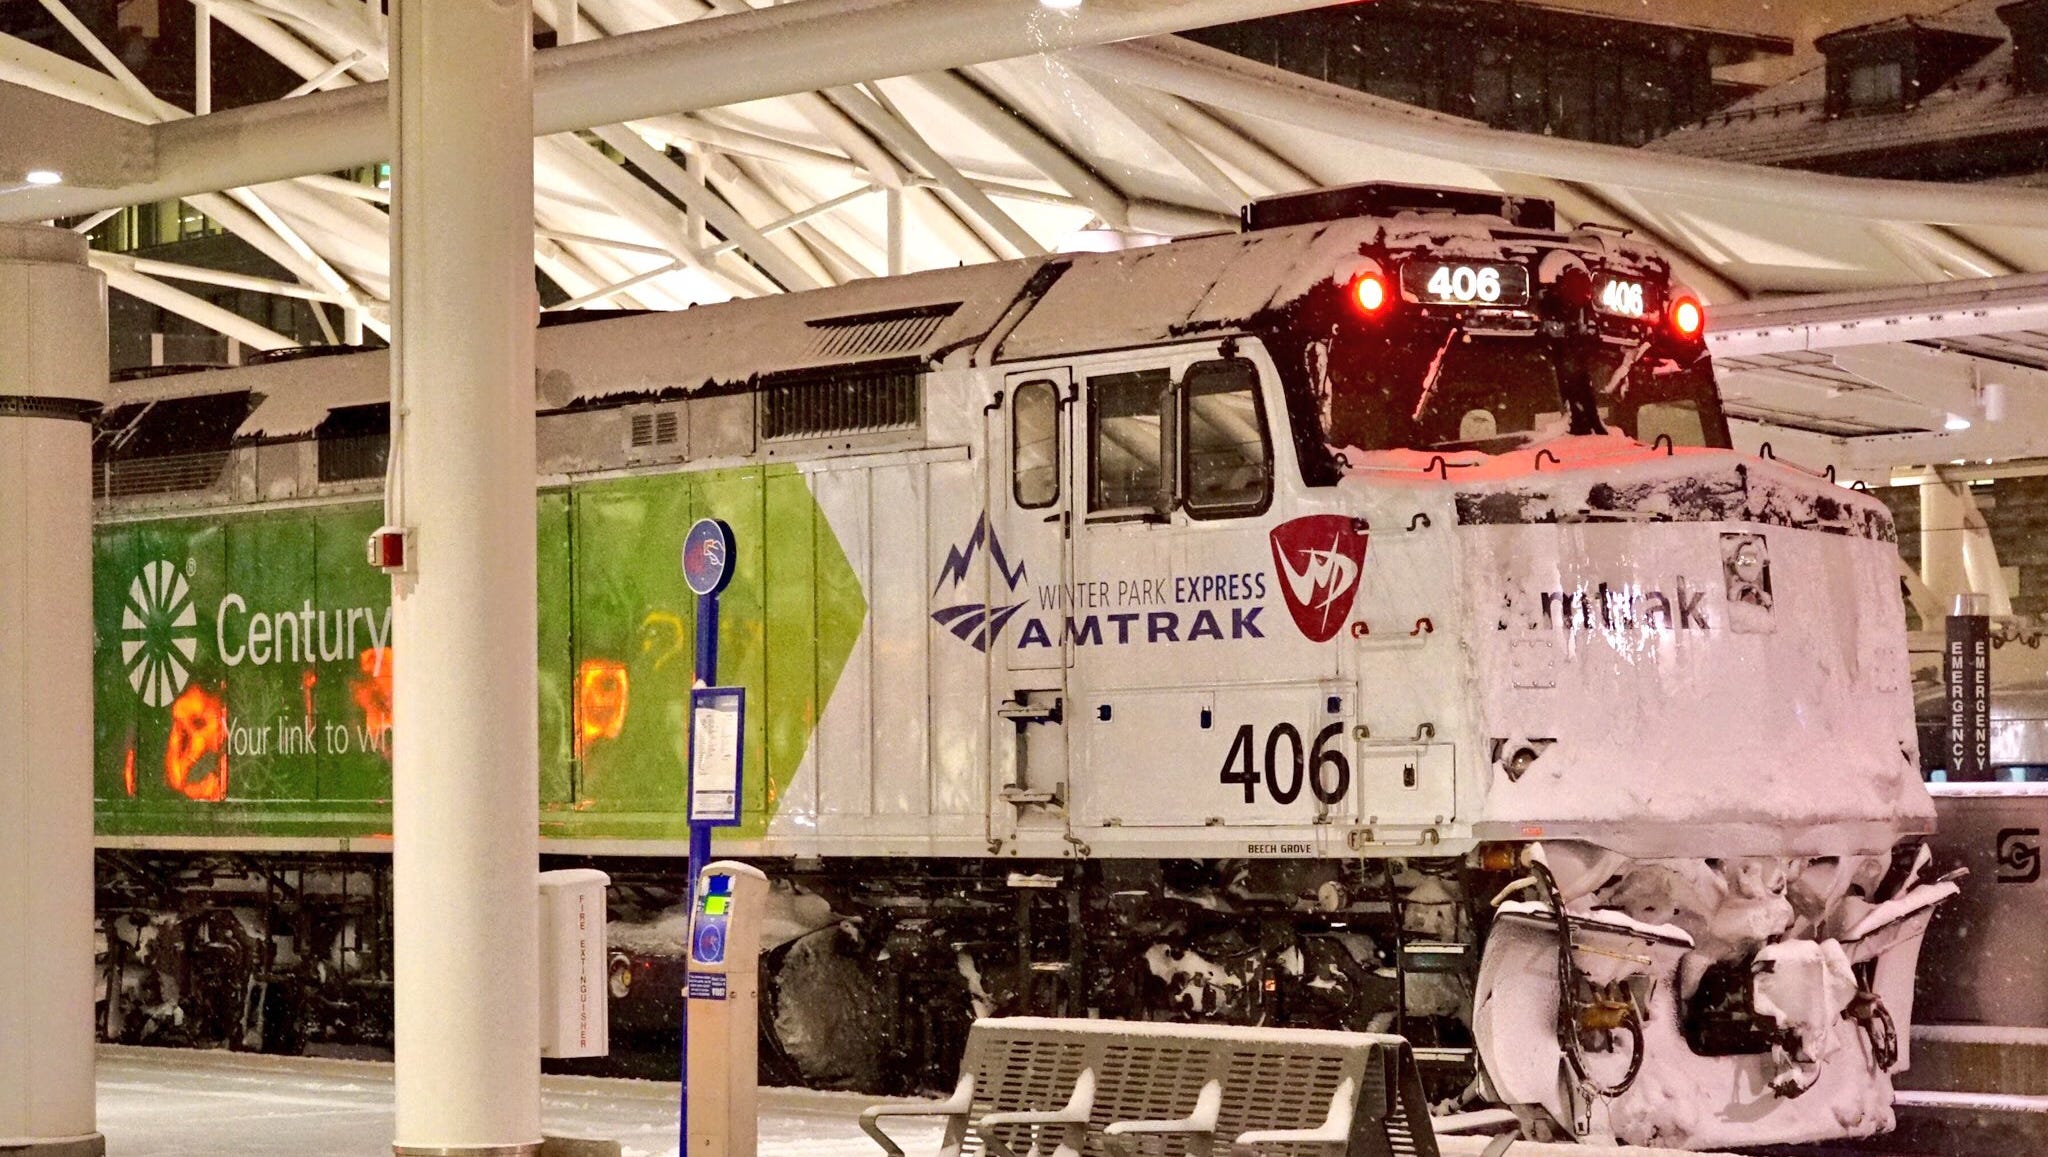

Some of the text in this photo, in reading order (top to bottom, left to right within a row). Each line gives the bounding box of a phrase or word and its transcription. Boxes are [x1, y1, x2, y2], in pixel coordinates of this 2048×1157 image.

[1427, 266, 1500, 301] 406
[1602, 280, 1643, 316] 406
[1038, 572, 1266, 610] WINTER PARK EXPRESS
[216, 593, 392, 677] Century
[1017, 606, 1266, 649] AMTRAK
[1951, 641, 1963, 771] EMERGENCY
[1975, 641, 1986, 771] EMERGENCY
[221, 716, 271, 755] Your
[278, 714, 317, 754] link
[325, 719, 349, 754] to
[1219, 721, 1350, 804] 406
[1247, 843, 1312, 854] BEECH GROVE
[579, 939, 588, 1048] EXTINGUISHER
